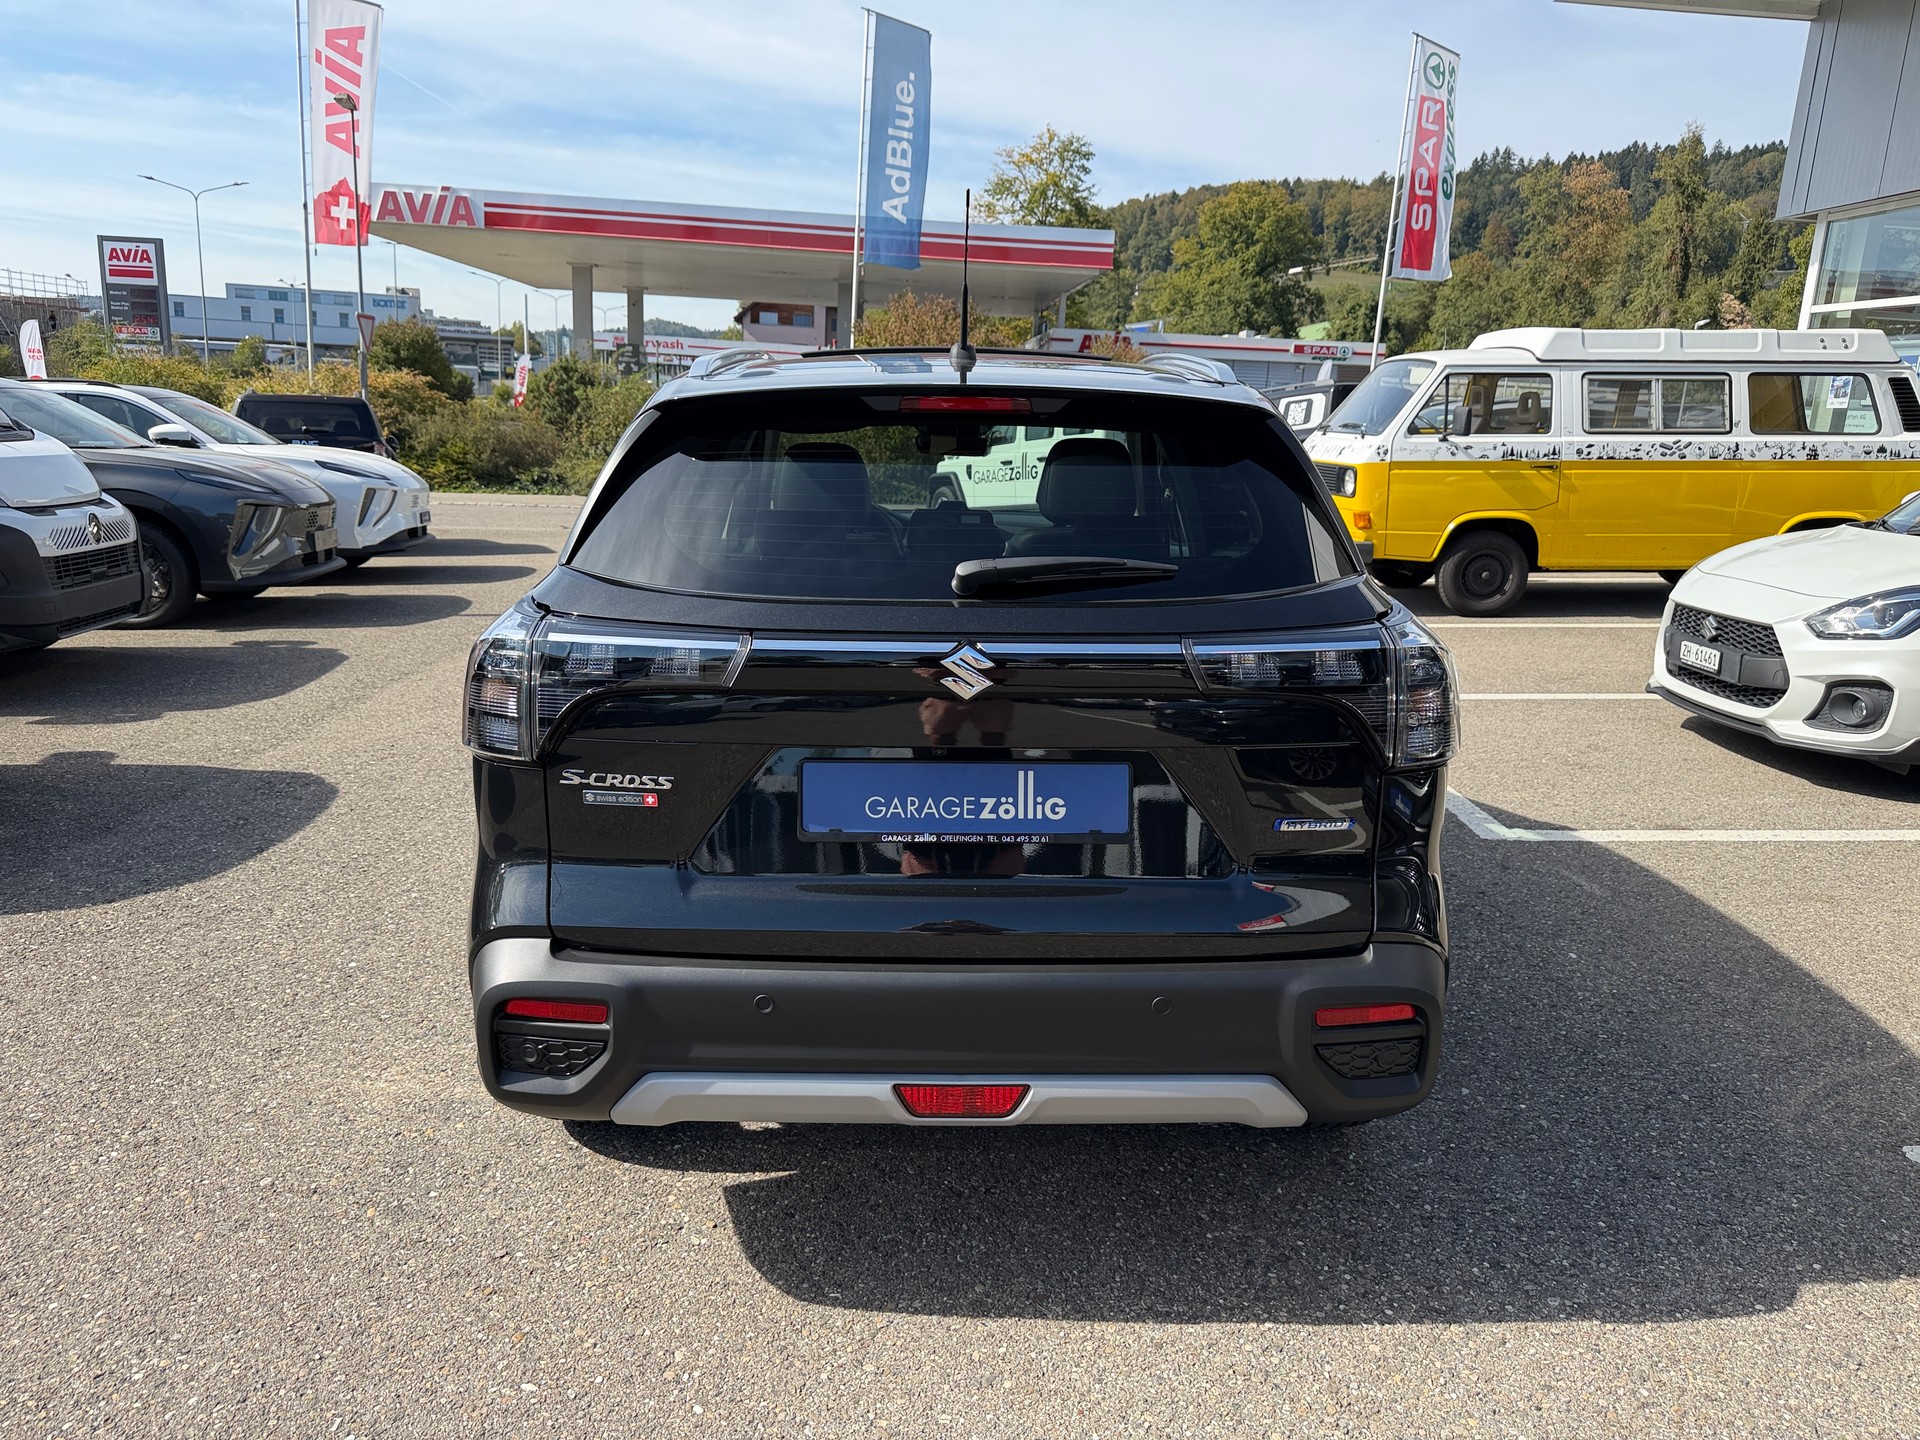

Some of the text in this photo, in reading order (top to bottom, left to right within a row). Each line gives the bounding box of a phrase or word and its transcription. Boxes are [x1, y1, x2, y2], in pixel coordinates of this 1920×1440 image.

[315, 26, 366, 159] AVIA
[1411, 100, 1442, 231] SPAR
[376, 185, 477, 227] AVIA
[108, 245, 152, 263] AVIA
[121, 327, 148, 335] SPAR
[1303, 345, 1337, 355] SPAR
[559, 769, 674, 790] S-CROSS
[596, 795, 643, 803] swiss edition
[1286, 821, 1344, 830] HYBRID
[881, 834, 912, 842] GARAGE
[1001, 835, 1015, 843] 043
[1016, 835, 1029, 843] 495
[1031, 835, 1040, 843] 30
[1041, 835, 1049, 843] 61
